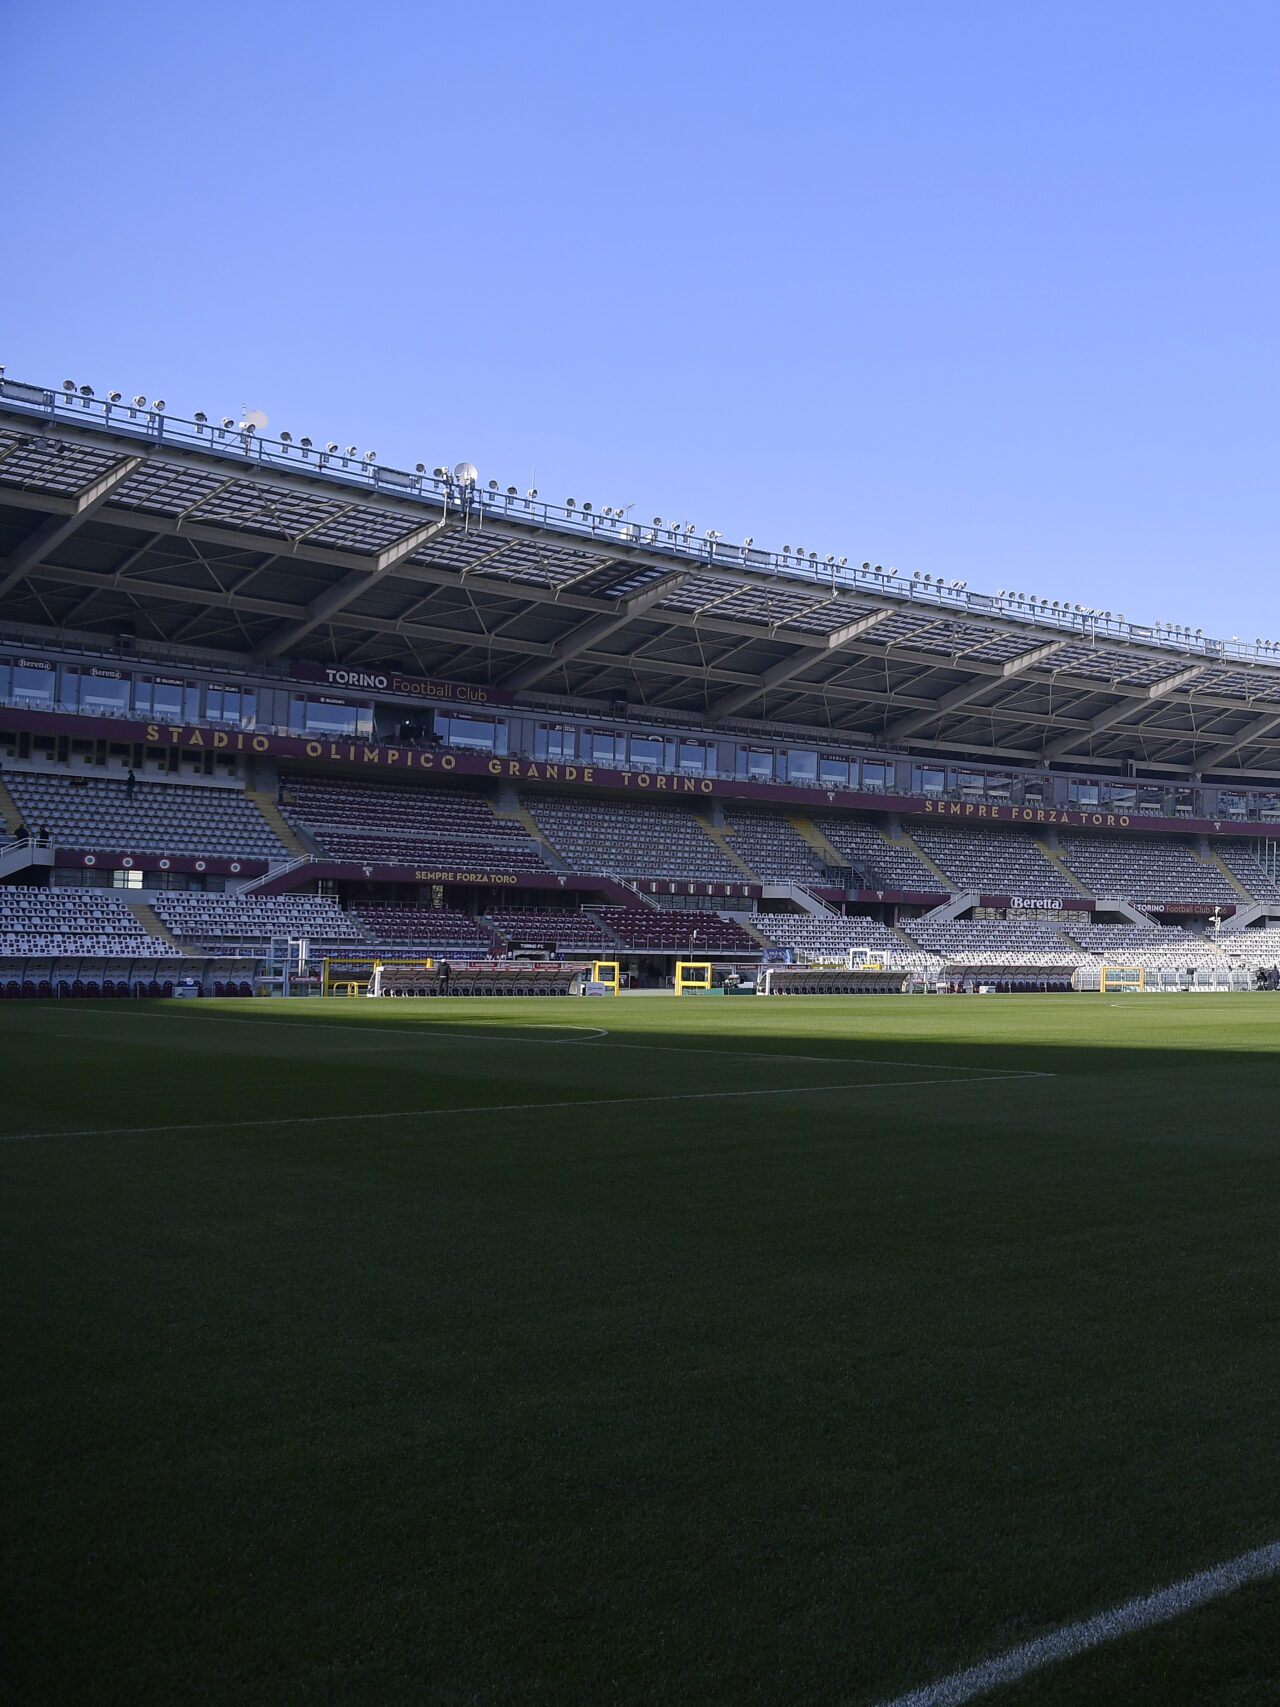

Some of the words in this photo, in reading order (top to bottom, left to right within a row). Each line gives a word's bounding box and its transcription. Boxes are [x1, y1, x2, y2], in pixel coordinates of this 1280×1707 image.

[19, 659, 51, 670] Beretta
[90, 667, 121, 679] Beretta
[326, 669, 388, 688] TORINO
[393, 679, 452, 697] Football
[456, 687, 487, 701] Club
[146, 724, 269, 751] STADIO
[306, 741, 456, 770] OLIMPICO
[488, 759, 593, 782] GRANDE
[621, 771, 713, 793] TORINO
[925, 800, 999, 817] SEMPRE
[1012, 808, 1069, 823] FORZA
[1080, 813, 1130, 826] TORO
[415, 871, 454, 880] SEMPRE
[457, 873, 488, 882] FORZA
[490, 875, 518, 884] TORO
[1011, 897, 1063, 909] Beretta
[1137, 904, 1164, 912] TORINO
[1194, 906, 1210, 914] Club
[1212, 906, 1227, 914] 106
